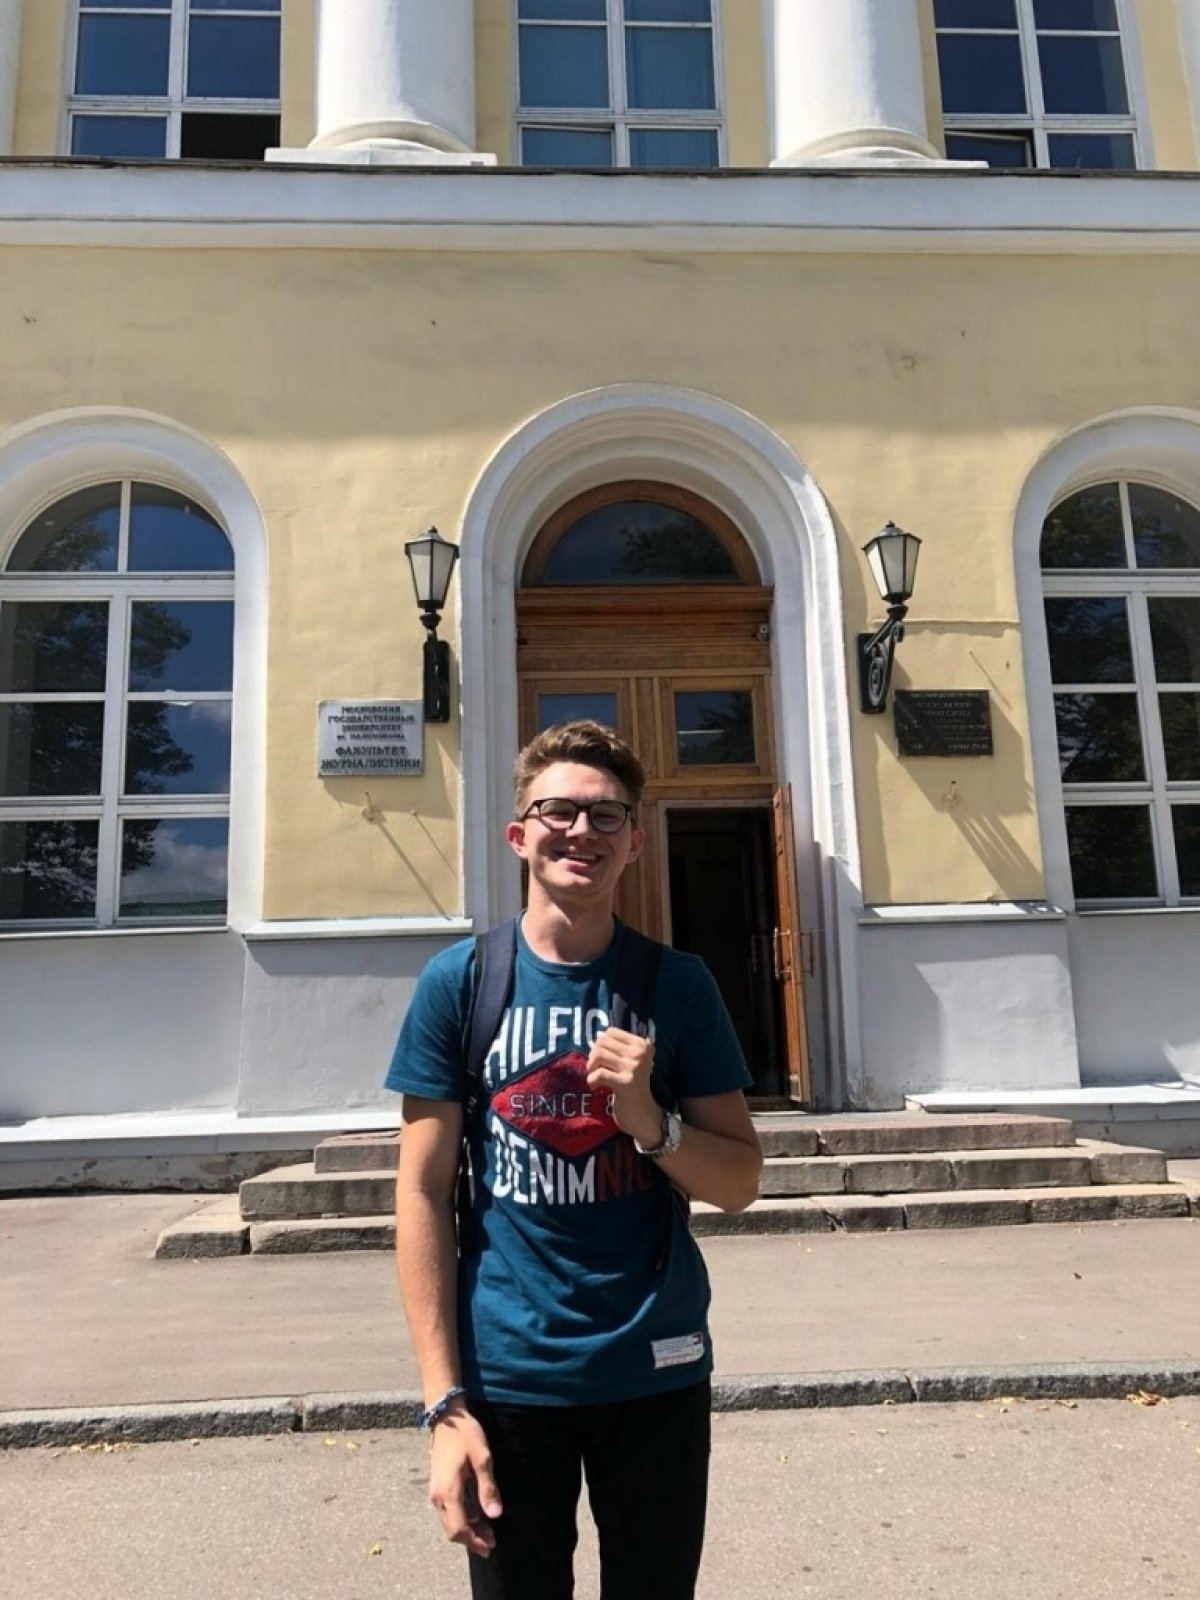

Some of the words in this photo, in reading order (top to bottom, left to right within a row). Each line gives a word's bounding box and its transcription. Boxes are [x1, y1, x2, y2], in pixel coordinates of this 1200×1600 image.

[335, 746, 407, 756] ФАКУЛЬТЕТ
[320, 758, 421, 769] ЖУРНАЛИСТИКИ
[510, 1093, 592, 1118] SINCE
[491, 1114, 596, 1206] DENIM
